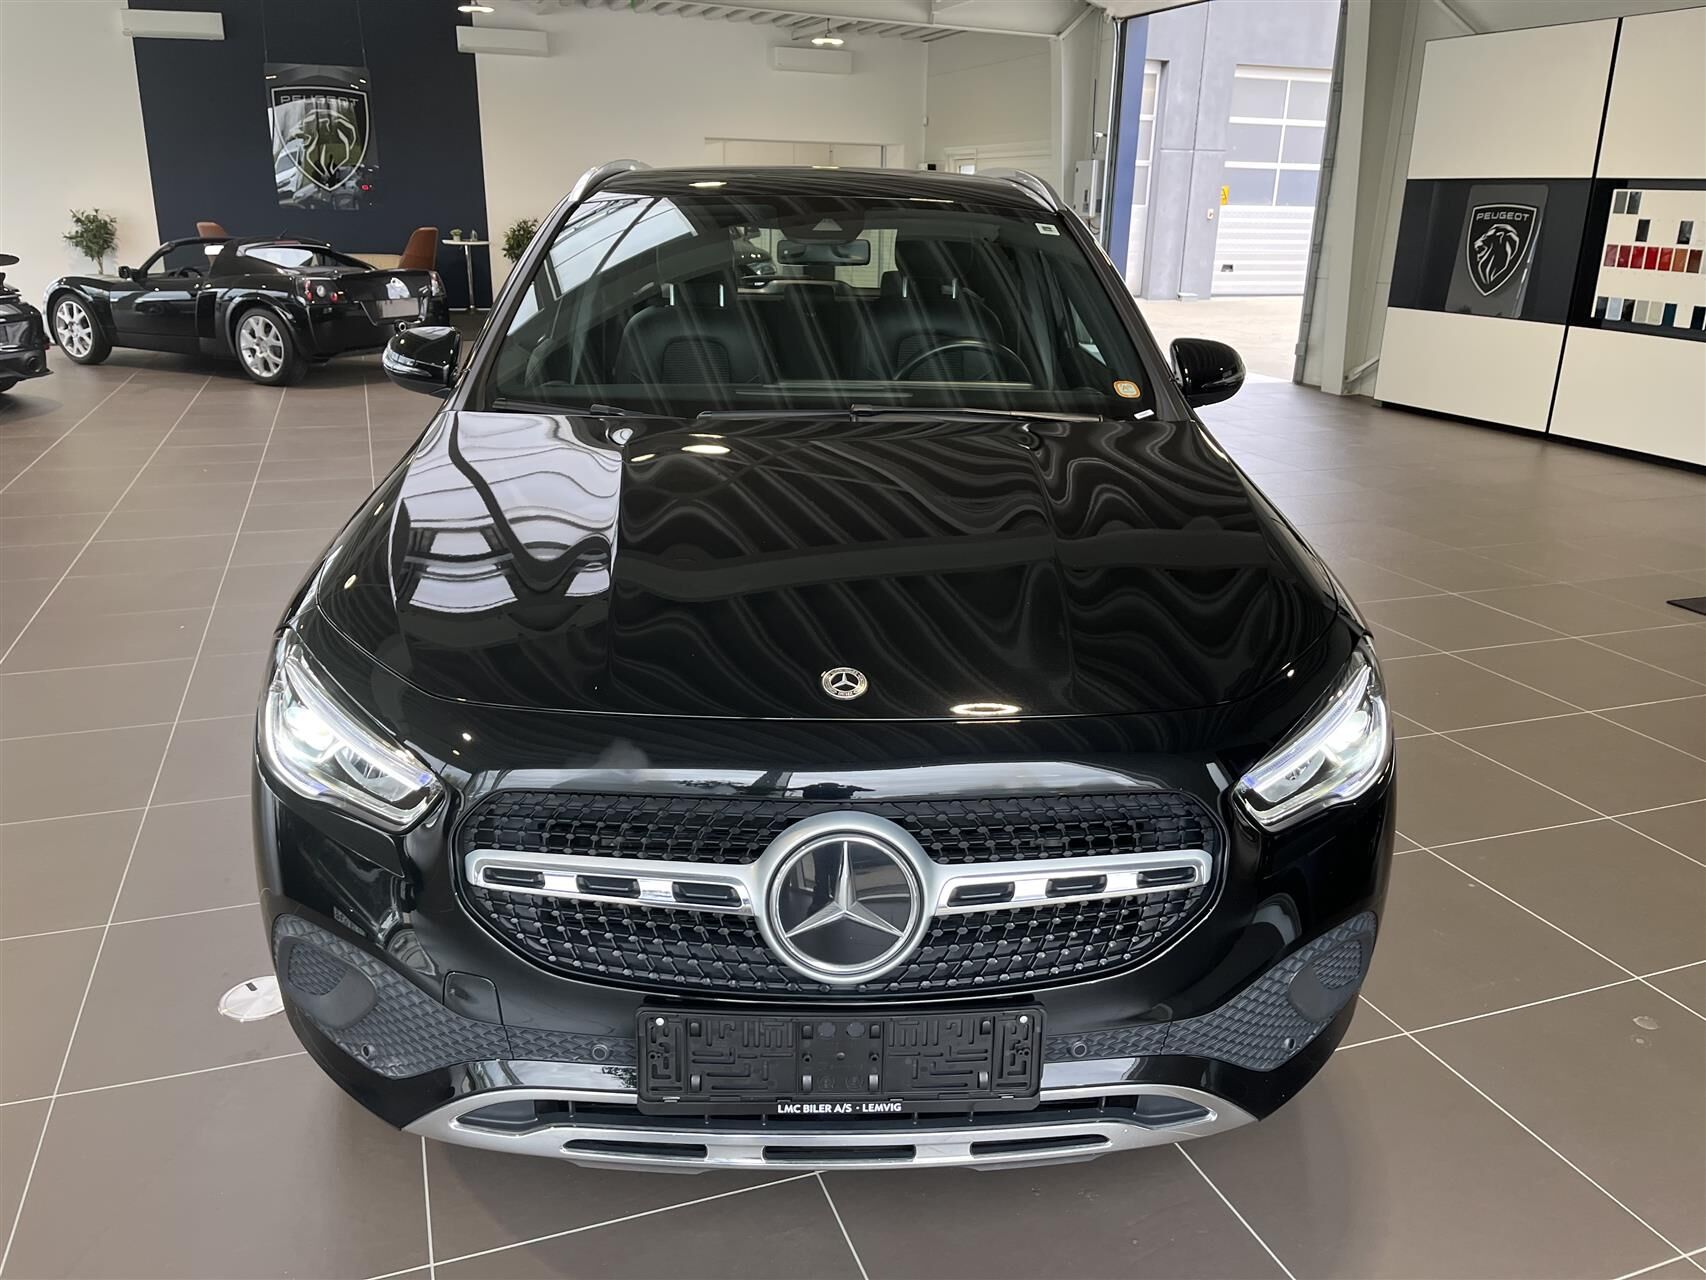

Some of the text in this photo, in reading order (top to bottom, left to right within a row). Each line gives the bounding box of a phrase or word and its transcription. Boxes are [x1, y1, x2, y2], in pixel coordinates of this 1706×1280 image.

[1476, 211, 1530, 221] PEUGEOT
[777, 1103, 902, 1114] LMC BILER A/S LEMVIG
